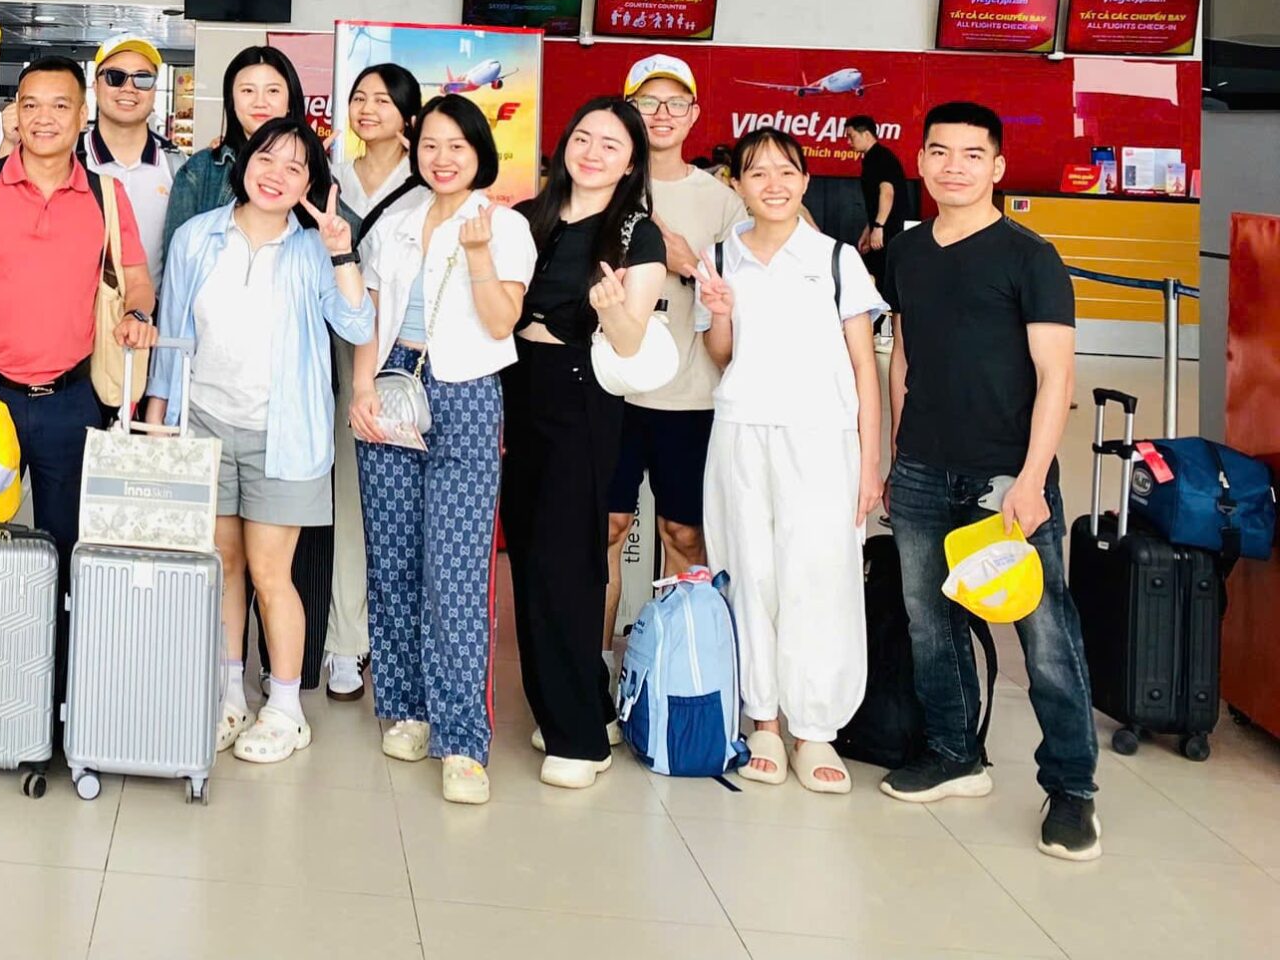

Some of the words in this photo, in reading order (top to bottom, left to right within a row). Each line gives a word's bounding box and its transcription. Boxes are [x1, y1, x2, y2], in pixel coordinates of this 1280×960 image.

[1103, 22, 1136, 30] FLIGHTS
[1137, 23, 1177, 31] CHECK-IN
[802, 146, 831, 158] Thích
[833, 148, 860, 161] ngay
[623, 532, 640, 564] the
